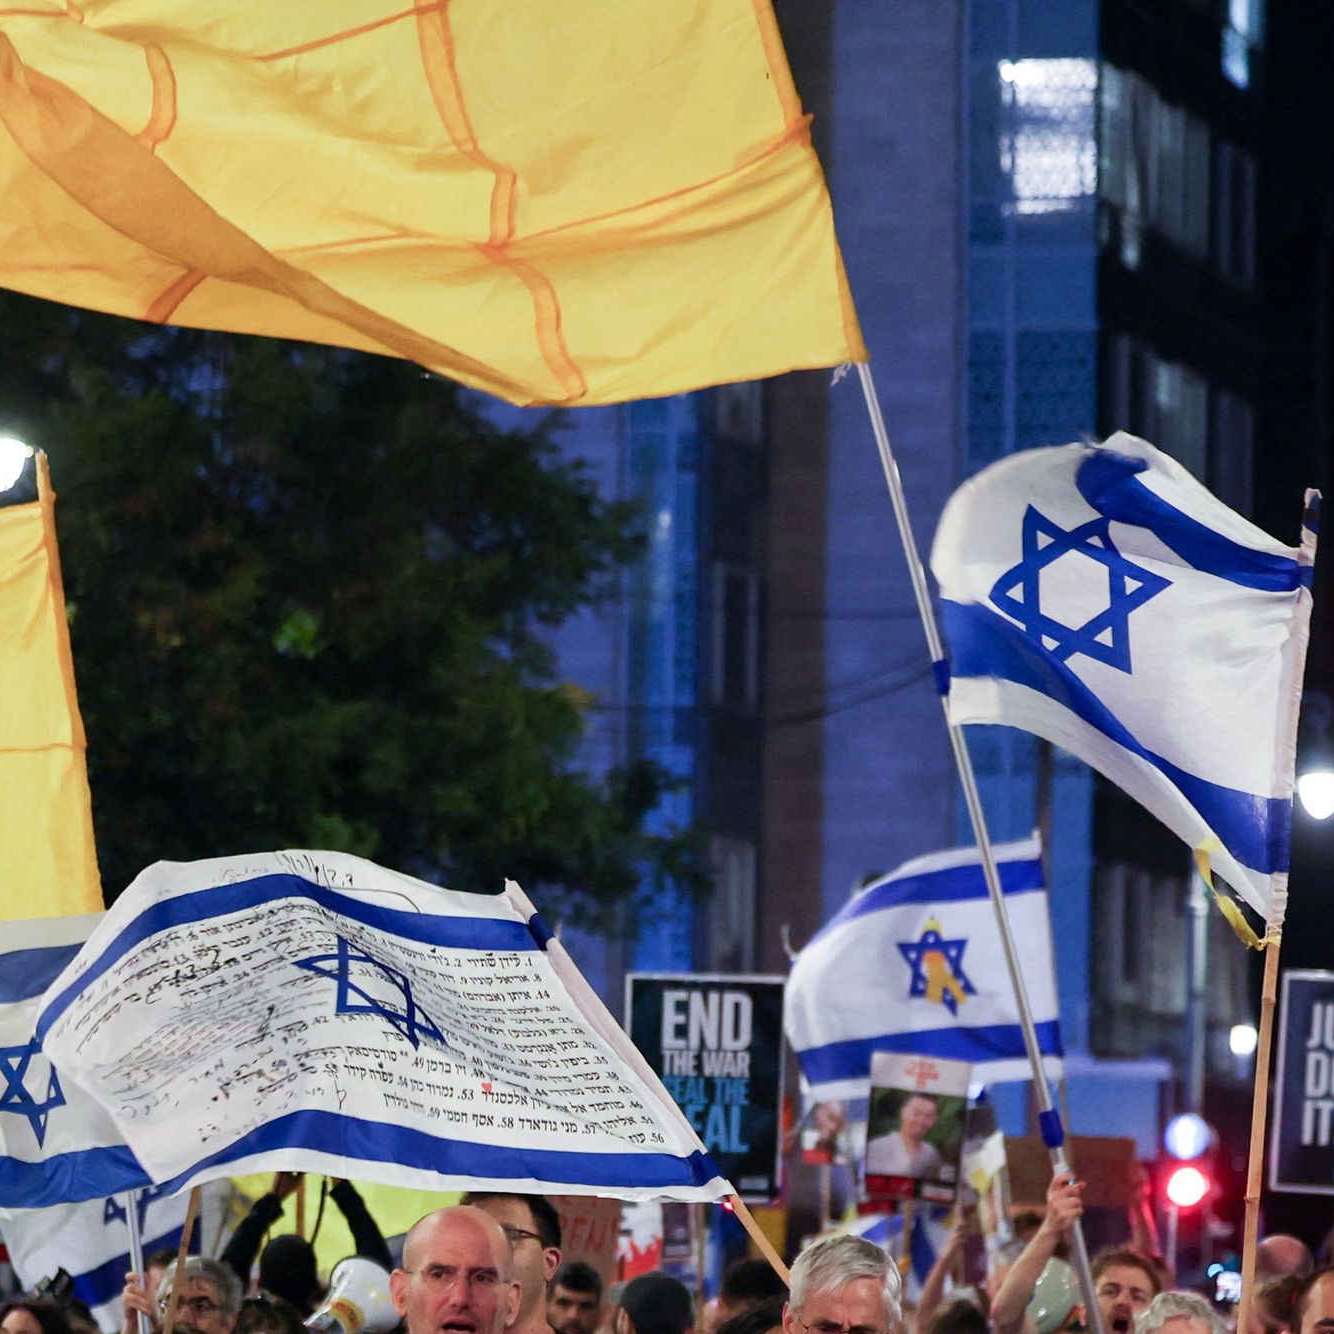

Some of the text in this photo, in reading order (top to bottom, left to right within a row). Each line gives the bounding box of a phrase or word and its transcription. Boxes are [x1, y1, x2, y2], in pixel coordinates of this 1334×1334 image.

[453, 957, 463, 968] 2.
[467, 956, 497, 968] שתיוי
[500, 955, 522, 970] עידן
[469, 975, 493, 988] קוניו
[493, 973, 530, 985] אריאל
[533, 974, 543, 983] 8.
[462, 989, 551, 1003] 14. איתן (אברהם)
[661, 989, 754, 1052] END
[426, 1059, 452, 1074] ברמן
[454, 1063, 467, 1076] זיו
[661, 1052, 751, 1078] THE WAR
[343, 1064, 367, 1080] קידר
[369, 1068, 394, 1084] עפרה
[426, 1082, 454, 1098] נמרוד
[456, 1088, 474, 1101] 53.
[714, 1077, 751, 1105] THE
[426, 1107, 440, 1119] 59.
[588, 1100, 625, 1113] מוחמד
[443, 1110, 468, 1123] חממי
[472, 1113, 494, 1128] אסף
[496, 1117, 515, 1129] 58.
[603, 1113, 637, 1129] אליהו
[518, 1117, 558, 1132] גודארד
[560, 1121, 578, 1133] מני
[581, 1123, 597, 1135] 57.
[650, 1132, 666, 1144] 56.
